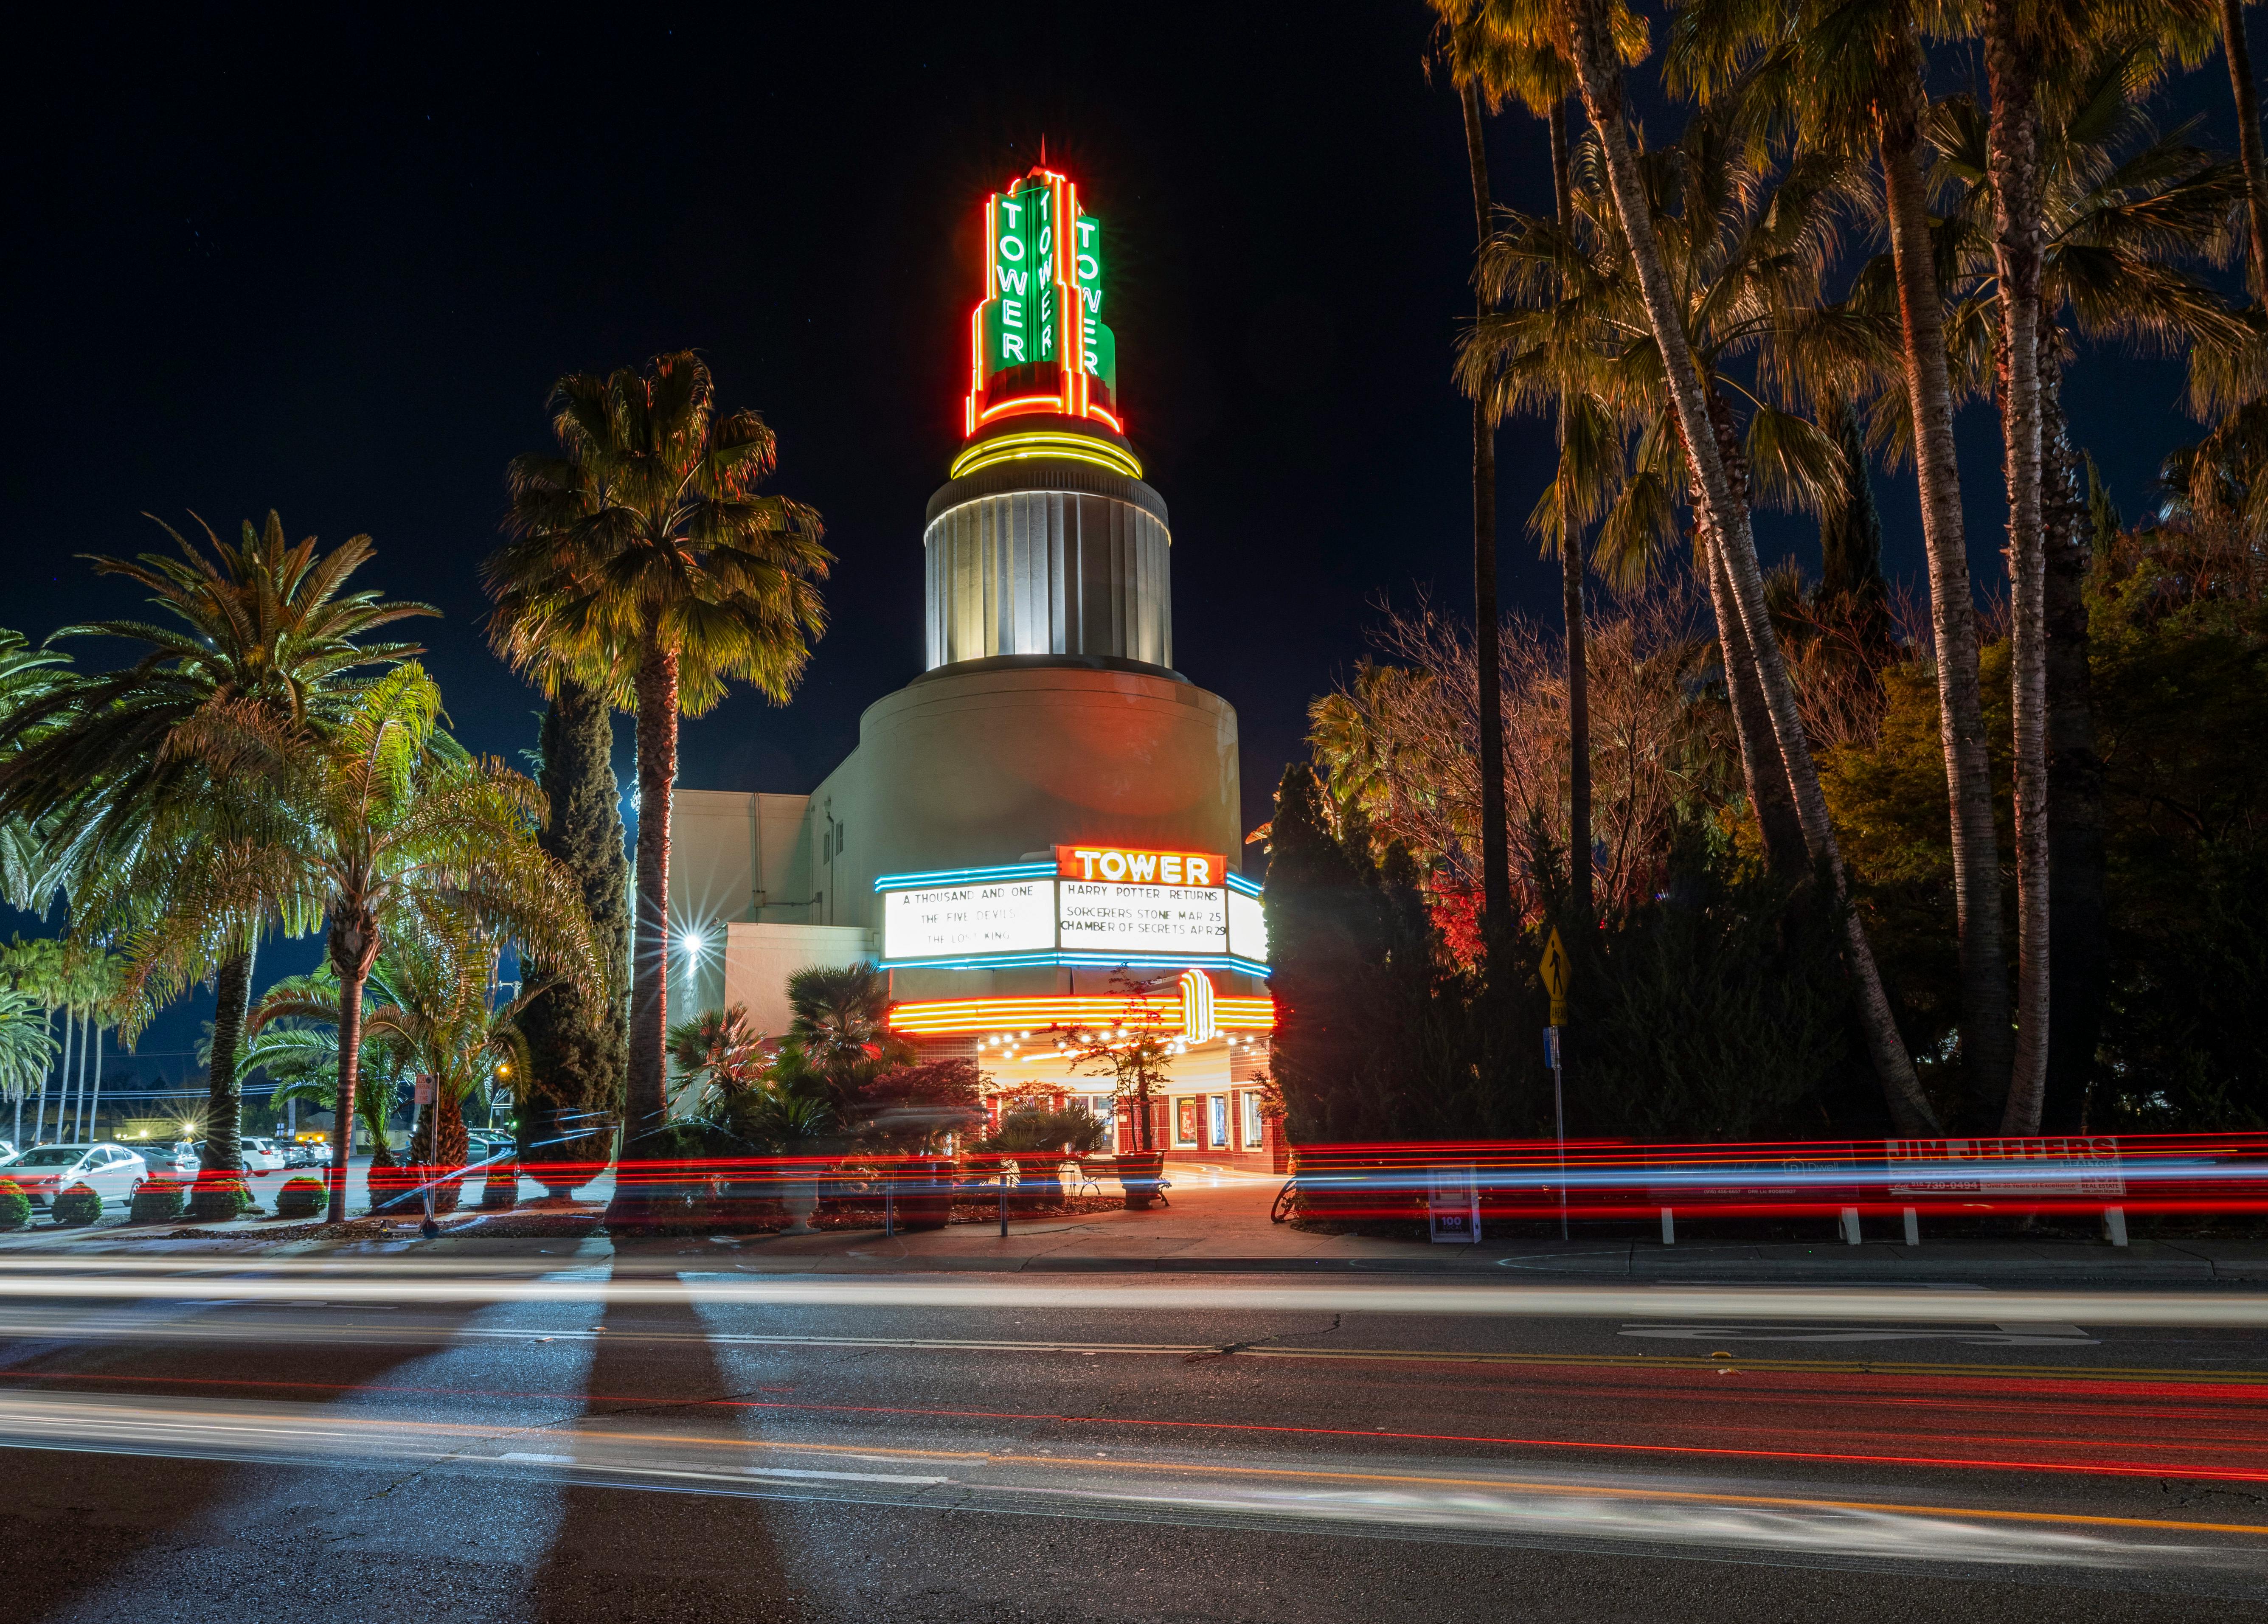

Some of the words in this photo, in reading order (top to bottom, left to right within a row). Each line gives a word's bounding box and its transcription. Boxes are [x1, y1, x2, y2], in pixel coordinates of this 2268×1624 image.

[996, 201, 1028, 362] TOWER
[1039, 191, 1053, 357] TOWER
[1075, 221, 1101, 376] TOWER
[1074, 850, 1209, 885] TOWER
[903, 895, 910, 905] A
[915, 891, 974, 903] THOUSAND
[981, 888, 1005, 899] AND
[1012, 885, 1033, 896] ONE
[1068, 885, 1107, 896] HARRY
[1116, 887, 1160, 898] POTTER
[1170, 890, 1217, 901] RETURNS
[921, 914, 939, 924] THE
[947, 912, 968, 922] FIVE
[977, 909, 1015, 920] DEVILS
[1067, 906, 1132, 918] SORCERERS
[1138, 909, 1172, 919] STONE
[1178, 910, 1203, 920] MAR
[1209, 912, 1221, 921] 25
[1060, 920, 1115, 932] CHAMBER
[1119, 923, 1134, 932] OF
[1138, 923, 1185, 934] SECRETS
[1191, 925, 1213, 935] APR
[1214, 926, 1226, 935] 29
[928, 935, 944, 944] THE
[952, 933, 976, 943] LO
[1551, 1006, 1566, 1019] AHEAD
[1889, 1141, 1949, 1161] JIM
[1959, 1138, 2116, 1161] JEFFERS
[1808, 1162, 1839, 1172] Dwell
[1894, 1182, 1909, 1190] Cell
[1924, 1181, 1978, 1189] 730-0494
